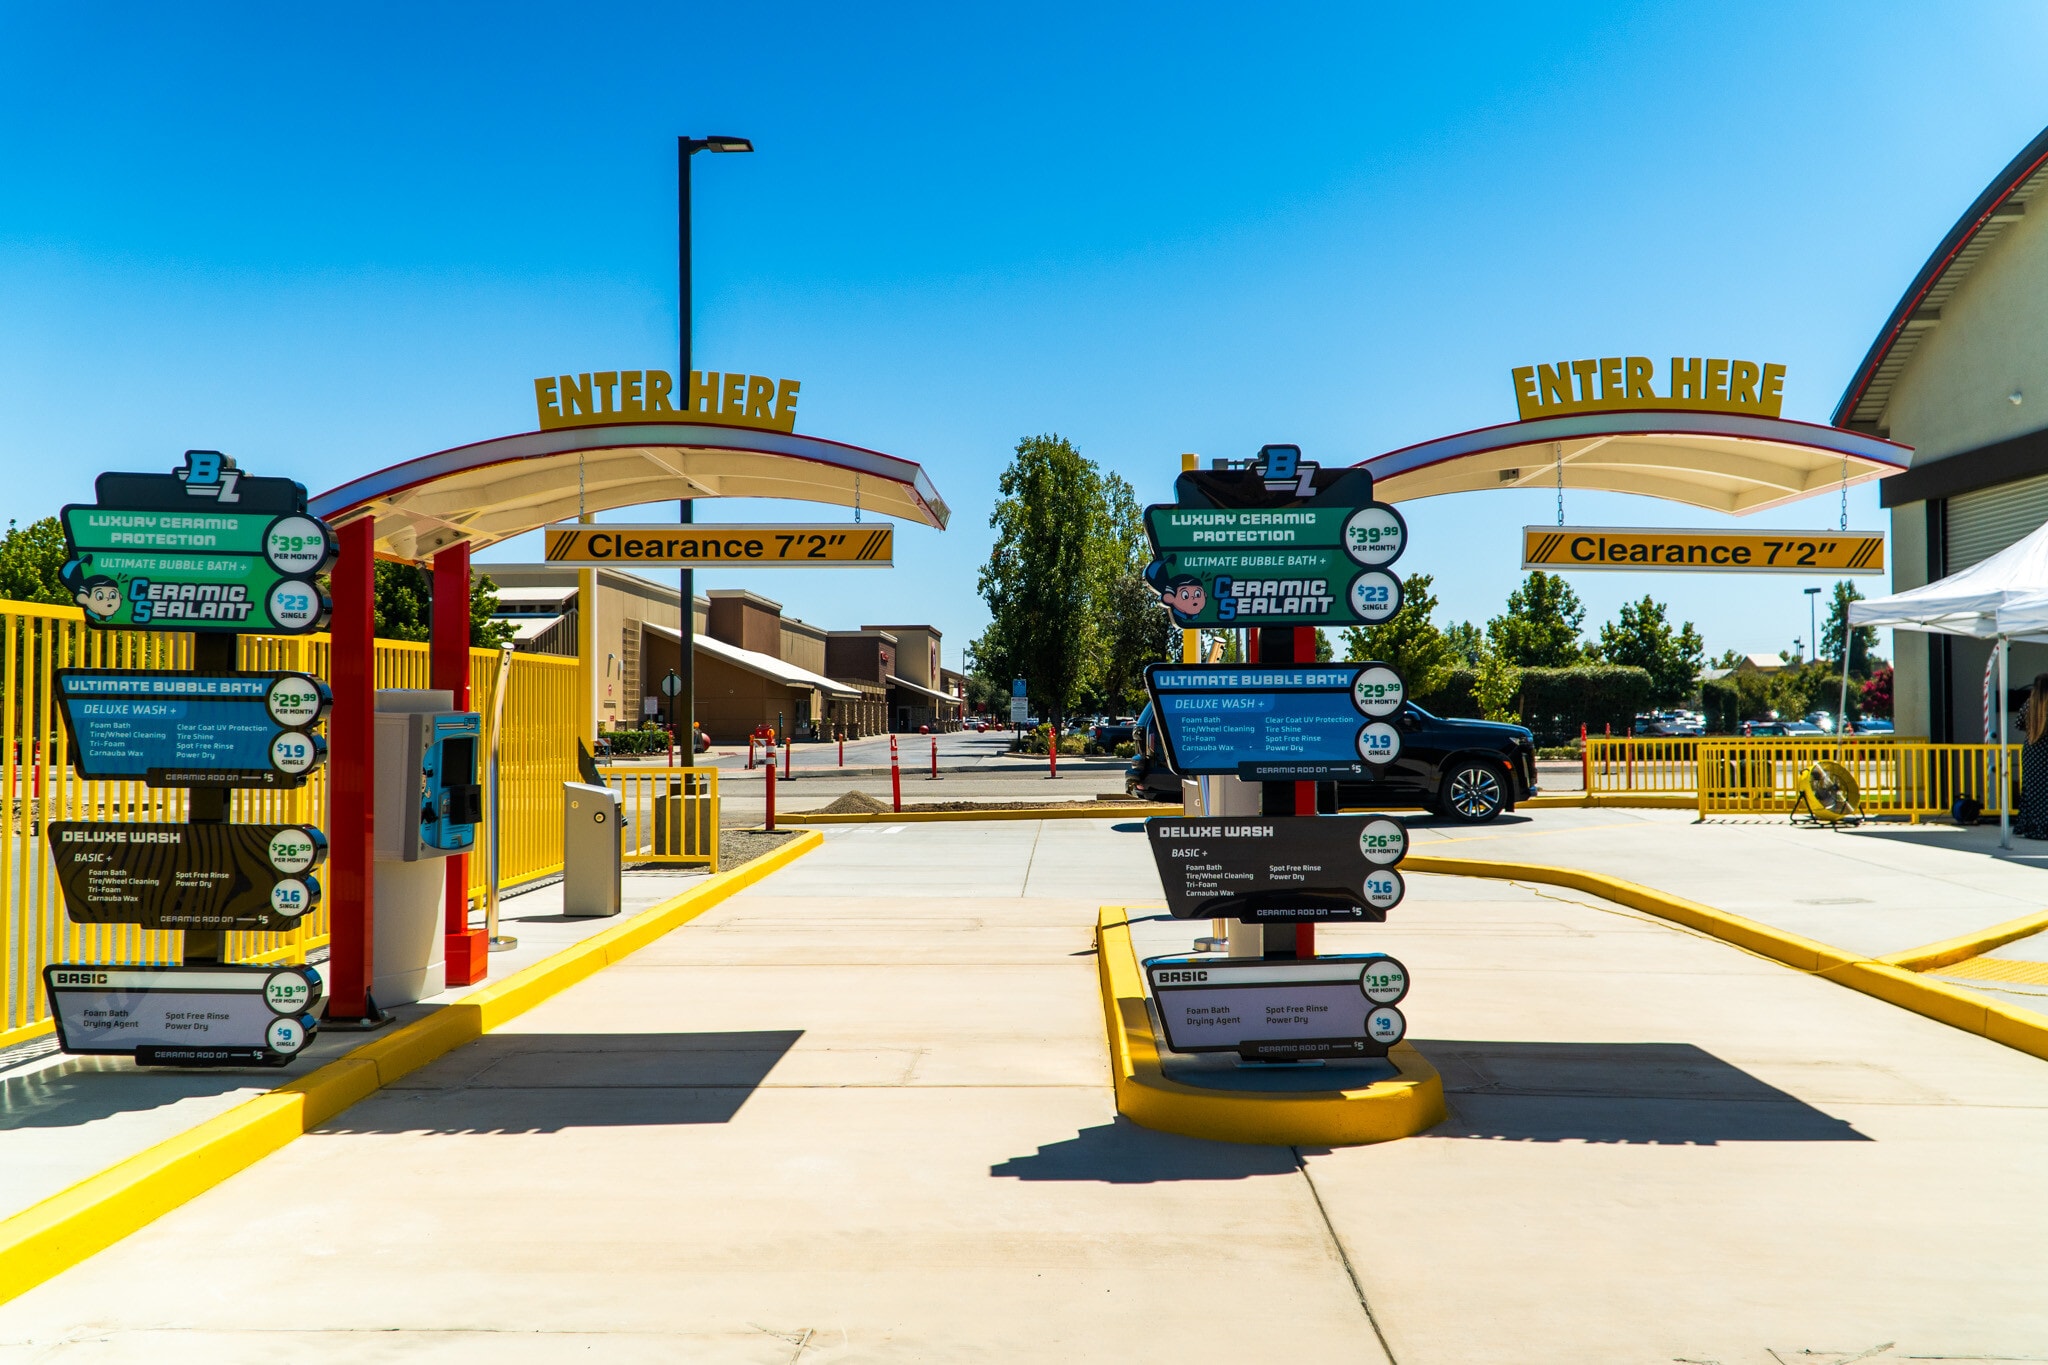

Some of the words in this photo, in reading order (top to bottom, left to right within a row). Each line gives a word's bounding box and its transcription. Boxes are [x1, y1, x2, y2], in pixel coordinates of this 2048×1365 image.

[1513, 356, 1656, 405] ENTER
[1671, 357, 1786, 405] HERE
[534, 370, 673, 416] ENTER
[690, 371, 801, 420] HERE
[89, 516, 157, 528] LUXURY
[160, 516, 239, 530] CERAMIC
[1172, 514, 1237, 525] LUXURY
[1240, 513, 1316, 524] CERAMIC
[111, 533, 216, 546] PROTECTION
[1194, 530, 1295, 542] PROTECTION
[1349, 527, 1398, 543] $39.99
[271, 534, 321, 551] $39.99
[588, 534, 763, 559] Clearance
[1571, 537, 1752, 563] Clearance
[100, 558, 157, 569] ULTIMATE
[159, 559, 204, 570] BUBBLE
[207, 561, 237, 571] BATH
[1184, 557, 1238, 567] ULTIMATE
[1241, 556, 1284, 566] BUBBLE
[1287, 556, 1316, 566] BATH
[130, 578, 247, 602] CERAMIC
[1214, 577, 1326, 598] CERAMIC
[1358, 585, 1388, 602] $23
[277, 593, 308, 610] $23
[1220, 596, 1333, 620] SEALANT
[134, 601, 253, 622] SEALANT
[68, 680, 149, 691] ULTIMATE
[154, 682, 216, 692] BUBBLE
[220, 683, 262, 693] BATH
[1160, 676, 1238, 686] ULTIMATE
[1242, 675, 1302, 685] BUBBLE
[1306, 675, 1347, 684] BATH
[1358, 683, 1400, 698] $29.99
[273, 693, 316, 707] $29.99
[1176, 700, 1218, 708] DELUXE
[1222, 699, 1255, 708] WASH
[84, 704, 128, 714] DELUXE
[133, 705, 166, 714] WASH
[1223, 726, 1254, 734] Cleaning
[1363, 734, 1391, 748] $19
[277, 743, 304, 757] $19
[1352, 764, 1361, 773] $5
[62, 831, 126, 842] DELUXE
[130, 832, 180, 843] WASH
[1160, 827, 1221, 837] DELUXE
[1225, 826, 1273, 837] WASH
[1362, 834, 1401, 847] $26.99
[272, 843, 311, 856] $26.99
[1172, 849, 1200, 857] BASIC
[1368, 880, 1392, 893] $16
[275, 889, 300, 902] $16
[57, 974, 107, 984] BASIC
[1160, 971, 1207, 982] BASIC
[1366, 975, 1402, 987] $19.99
[270, 985, 306, 997] $19.99
[1187, 1017, 1214, 1026] Drying
[1216, 1017, 1240, 1025] Agent
[1376, 1018, 1391, 1030] $9
[278, 1028, 292, 1040] $9
